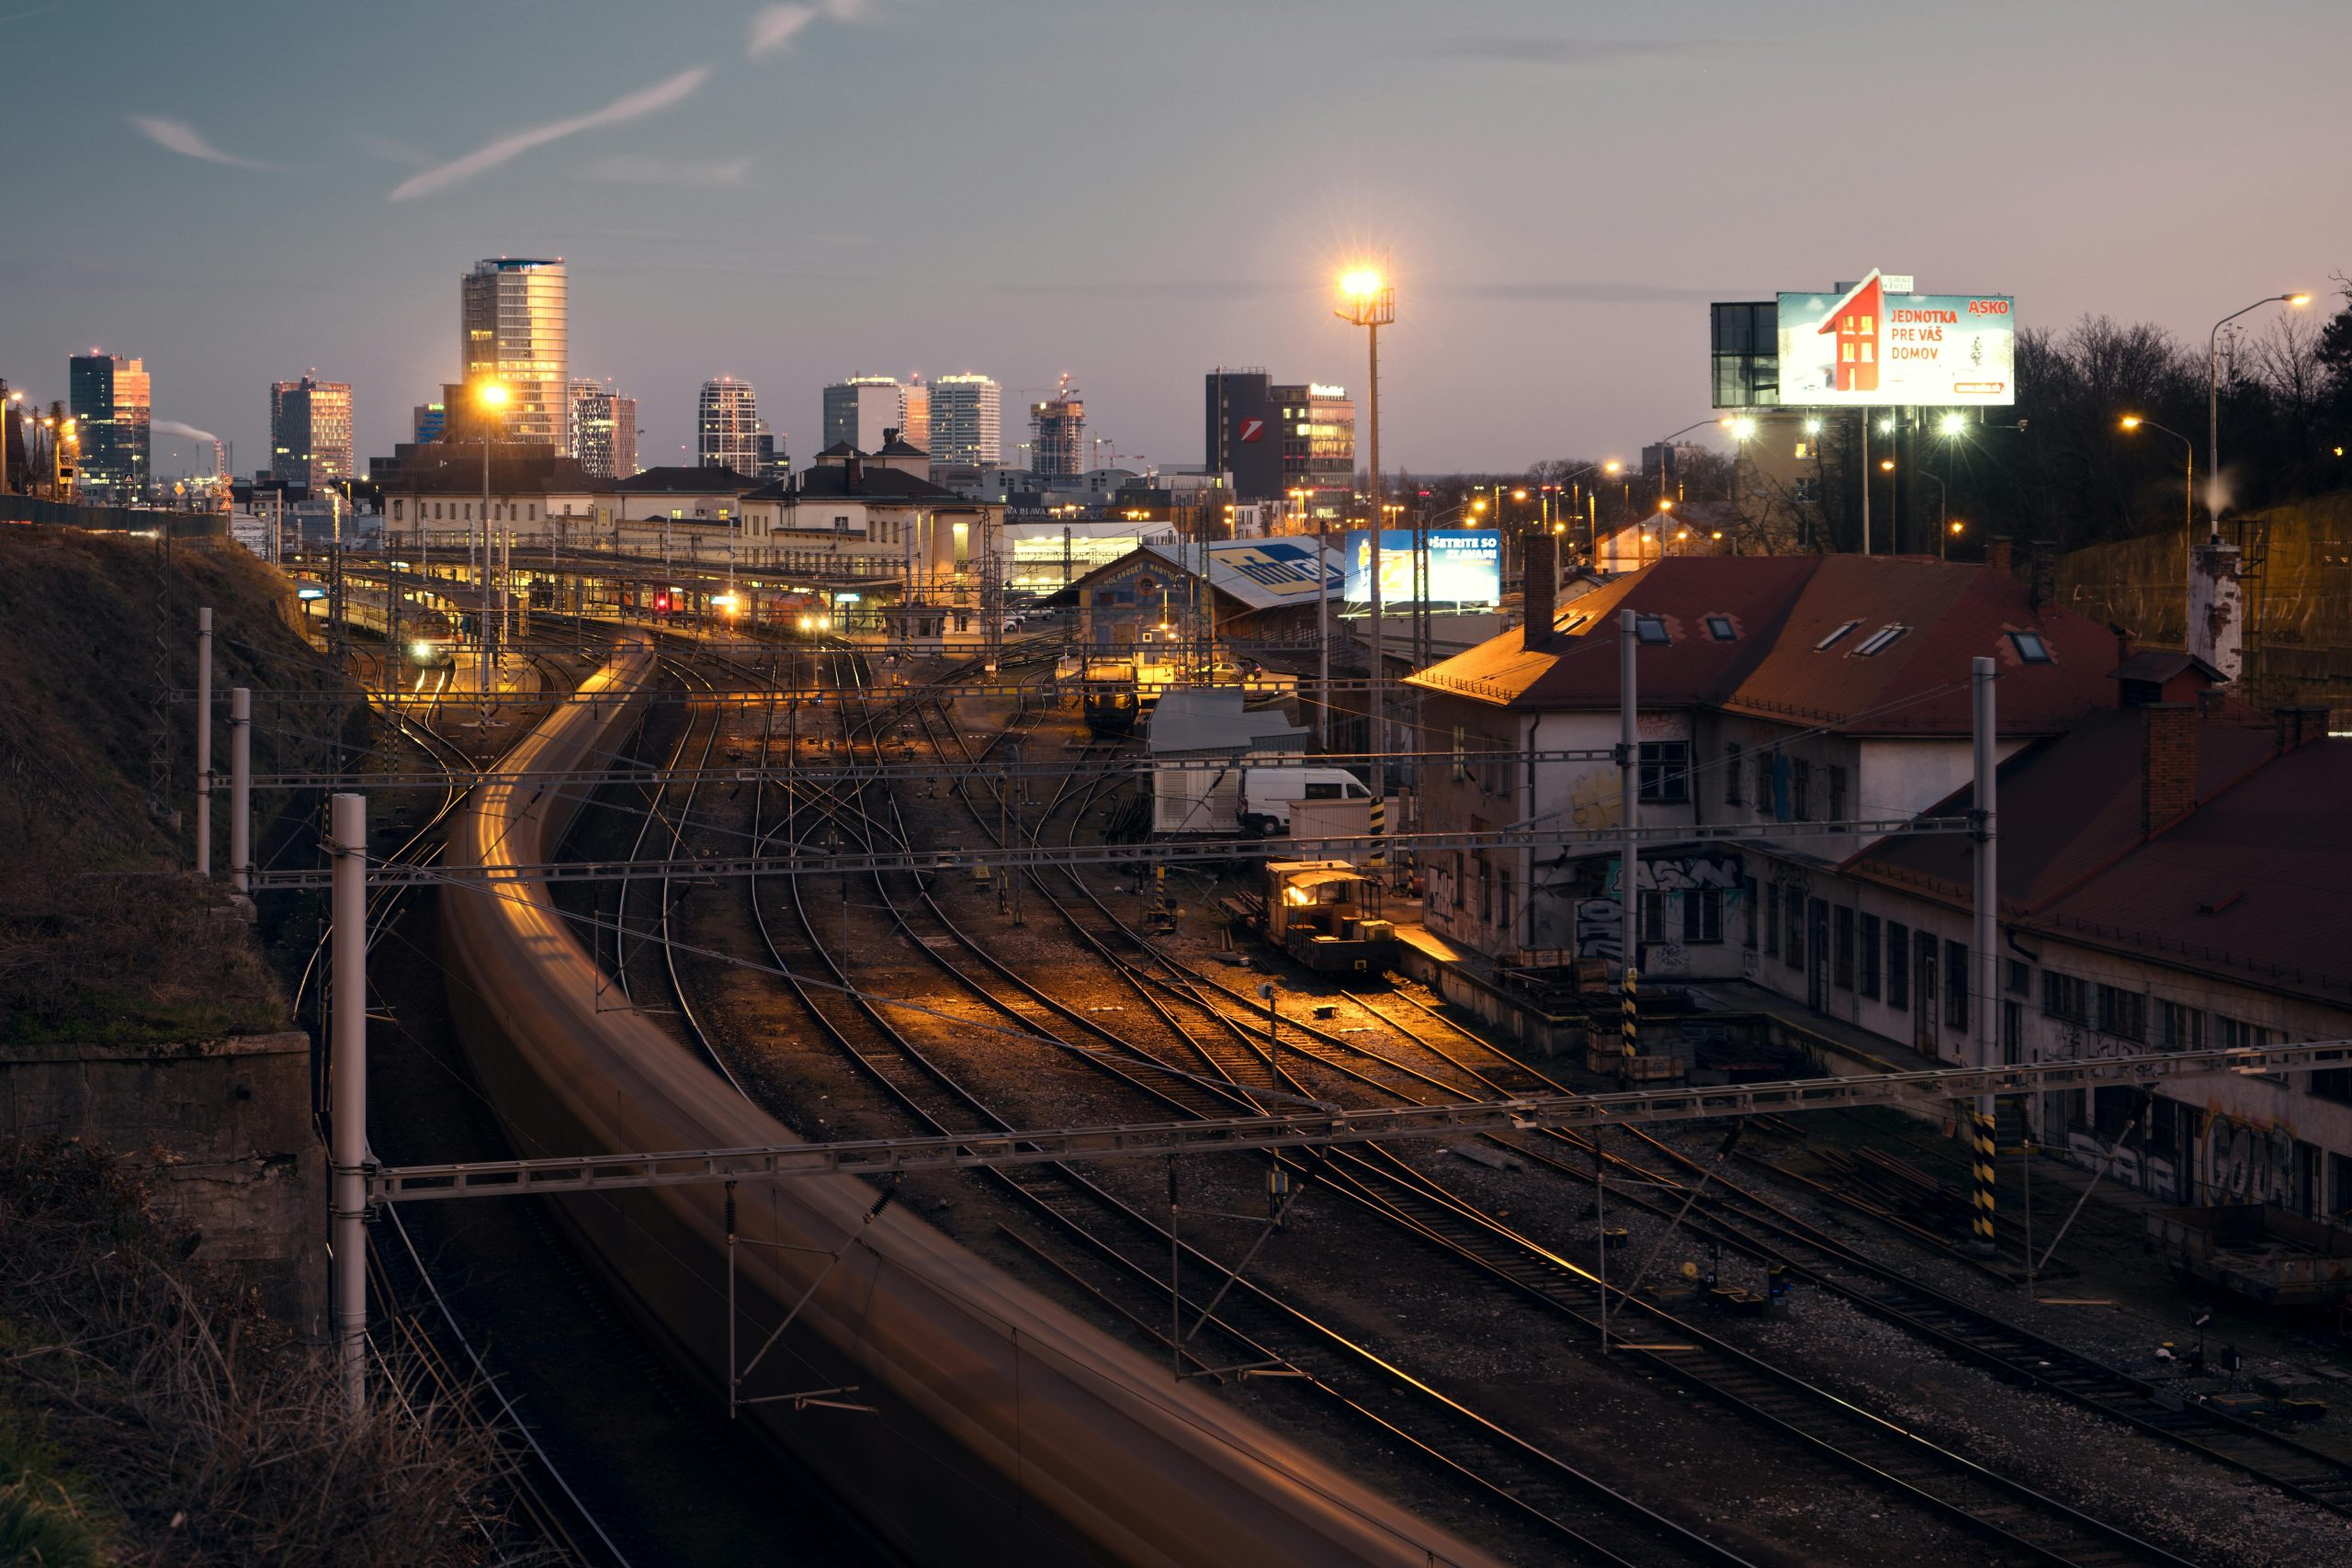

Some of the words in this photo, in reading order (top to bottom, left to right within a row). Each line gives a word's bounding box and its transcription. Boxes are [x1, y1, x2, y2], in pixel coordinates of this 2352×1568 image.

[1891, 309, 1958, 323] JEDNOTKA
[1968, 300, 2009, 318] ASKO
[1892, 329, 1916, 341] PRE
[1918, 325, 1943, 342] VÁŠ
[1892, 347, 1939, 359] DOMOV
[1481, 537, 1497, 548] SO
